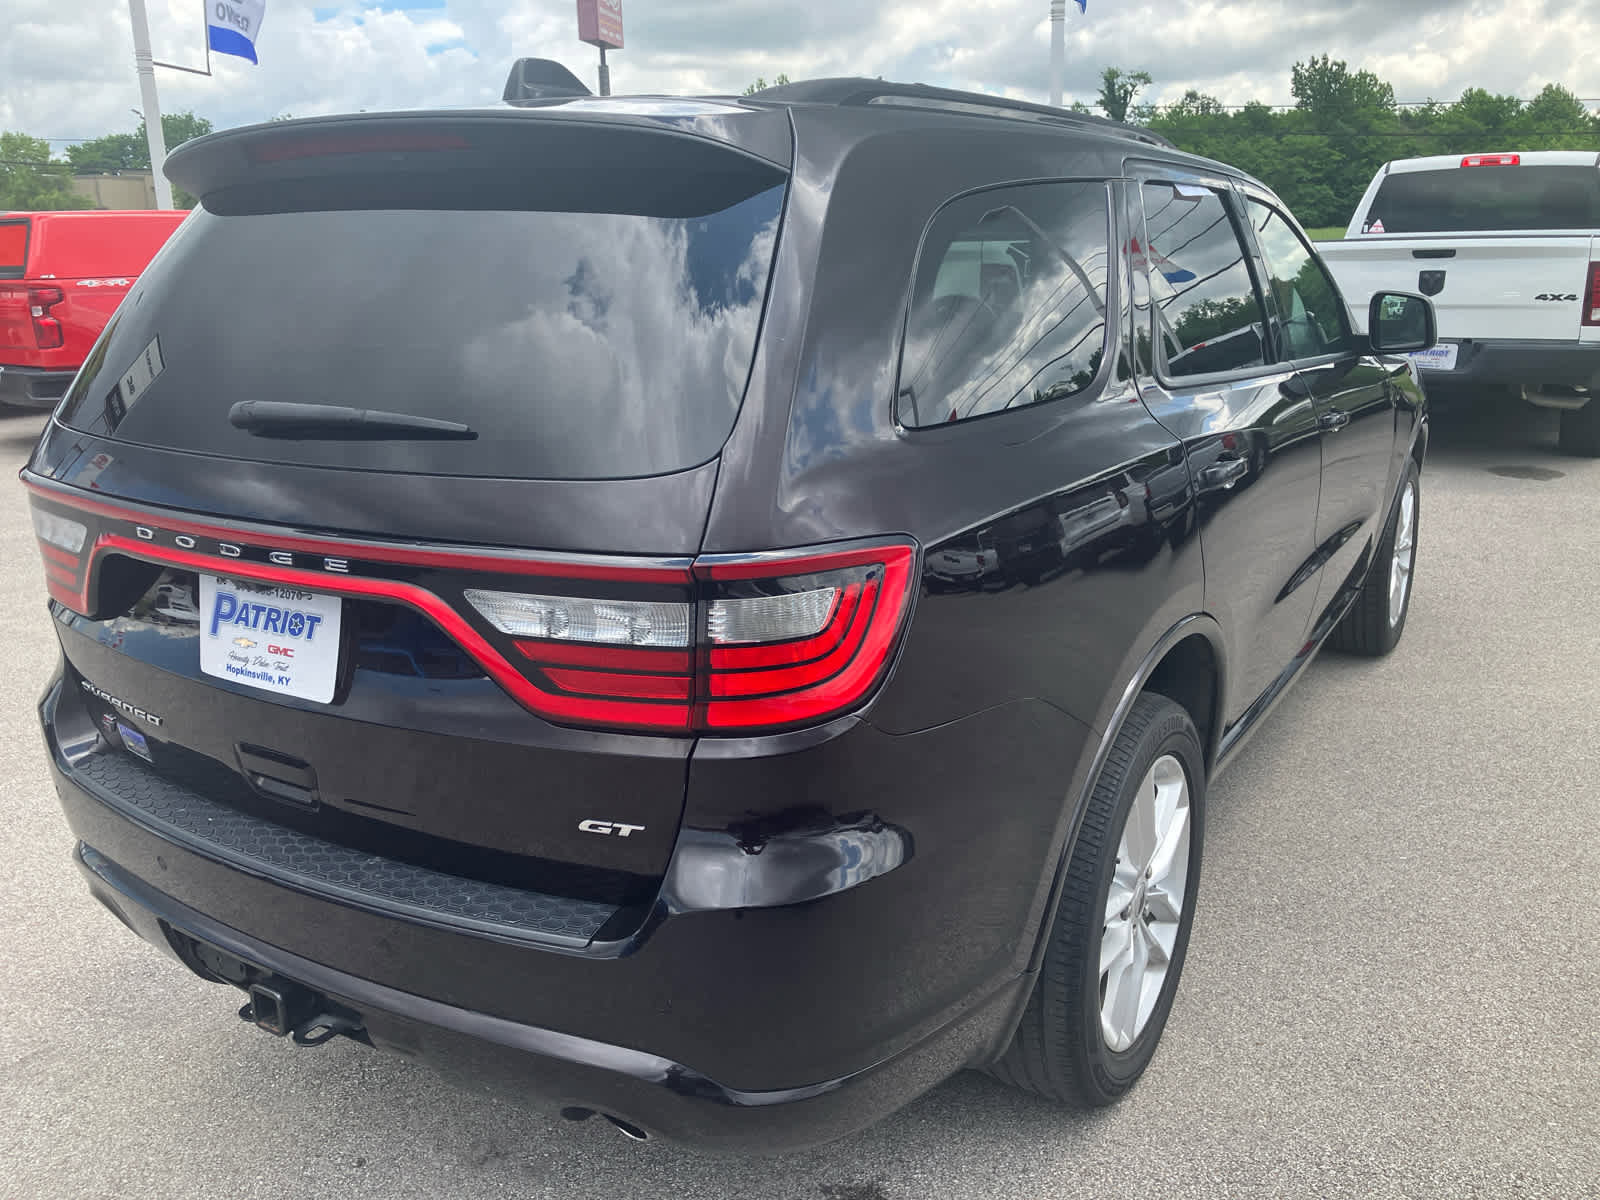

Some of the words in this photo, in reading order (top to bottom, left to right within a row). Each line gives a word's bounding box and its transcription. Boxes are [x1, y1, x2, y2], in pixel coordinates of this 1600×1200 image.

[1534, 293, 1579, 302] 4X4
[135, 525, 350, 574] DODGE
[208, 591, 322, 641] PATRIOT
[267, 643, 295, 658] GMC
[225, 663, 276, 685] Hopkinsville,
[277, 675, 292, 687] KY
[578, 819, 646, 837] GT
